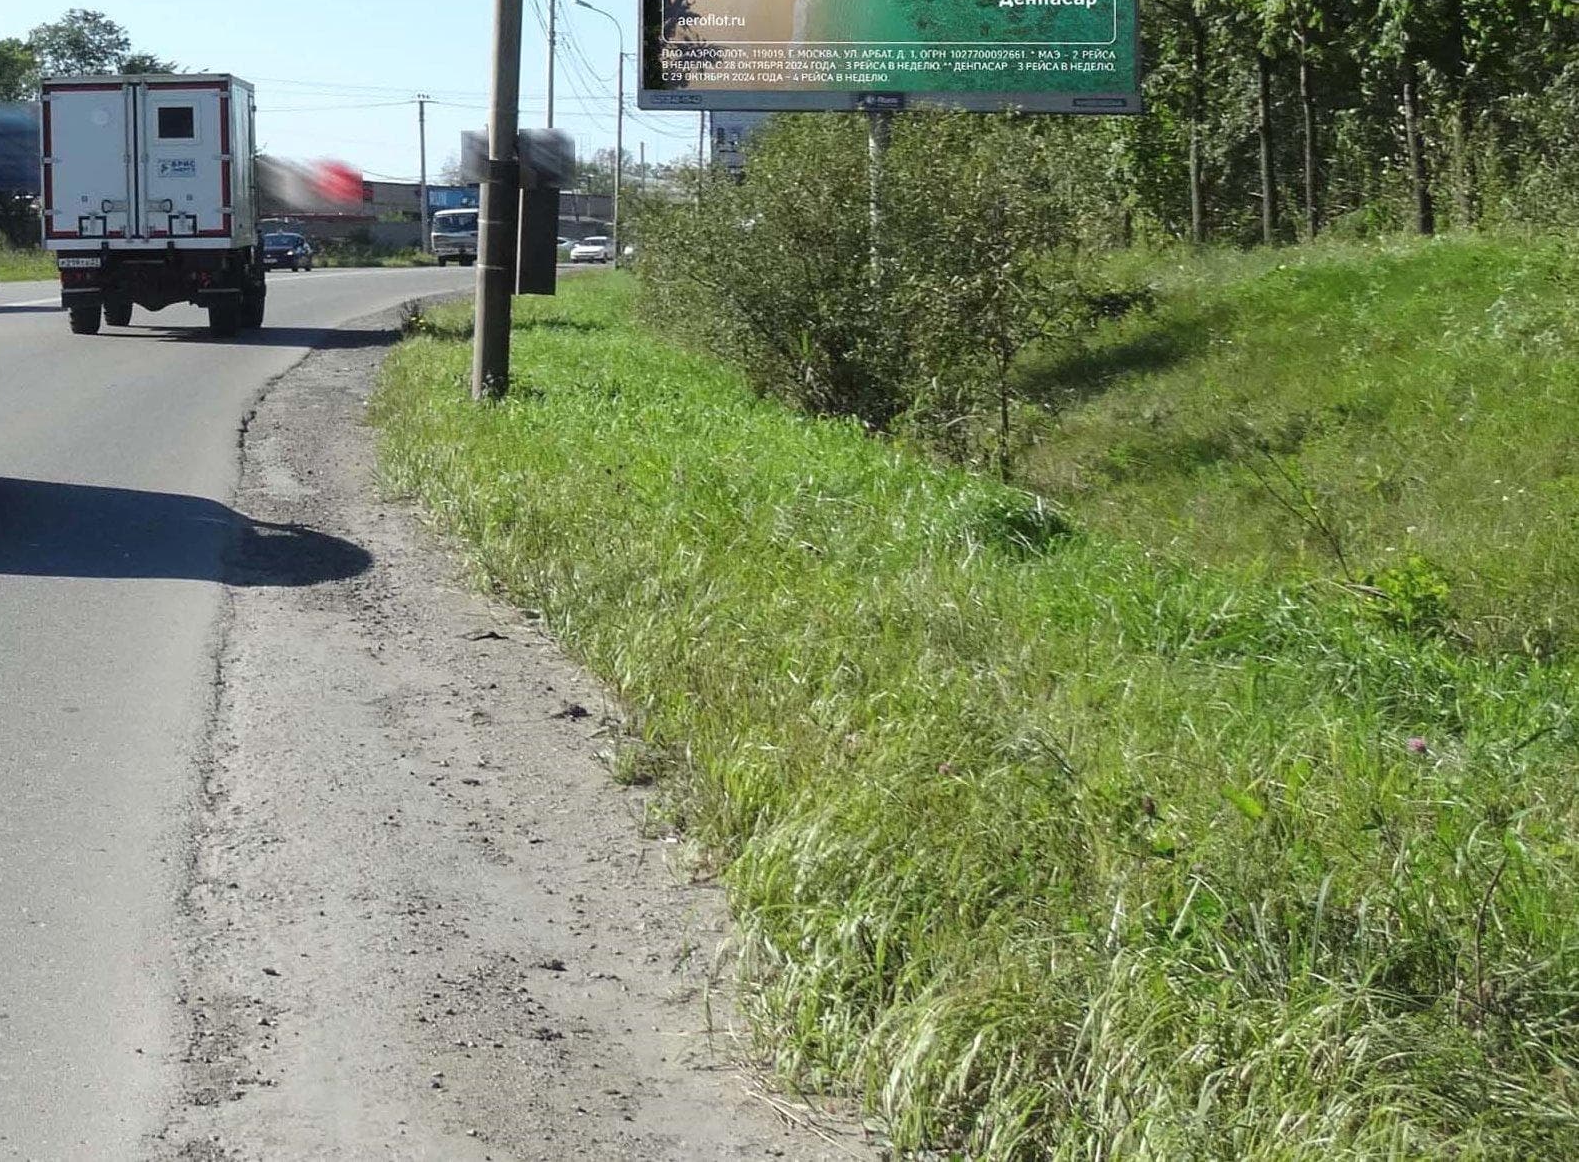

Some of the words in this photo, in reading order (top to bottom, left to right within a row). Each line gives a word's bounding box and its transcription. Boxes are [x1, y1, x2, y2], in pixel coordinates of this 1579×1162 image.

[678, 14, 746, 26] aeroflot.ru
[662, 48, 683, 58] ПАО
[919, 49, 947, 59] ОГРН
[1038, 50, 1061, 59] МАЭ
[1072, 50, 1079, 59] 2
[1082, 48, 1116, 59] РЕЙСА
[662, 60, 669, 69] В
[715, 61, 723, 69] С
[724, 61, 736, 70] 28
[738, 61, 784, 70] ОКТЯБРЯ
[785, 61, 809, 70] 2024
[810, 61, 837, 71] ГОДА
[845, 61, 852, 70] 3
[854, 59, 886, 70] РЕЙСА
[888, 62, 895, 70] В
[953, 61, 1008, 72] ДЕНПАСАР
[1017, 62, 1024, 71] 3
[1026, 60, 1060, 71] РЕЙСА
[1061, 62, 1068, 71] В
[662, 72, 669, 81] С
[671, 73, 683, 81] 29
[684, 73, 730, 81] ОКТЯБРЯ
[731, 73, 755, 81] 2024
[757, 73, 783, 82] ГОДА
[792, 73, 799, 81] 4
[801, 71, 834, 81] РЕЙСА
[836, 73, 843, 81] В
